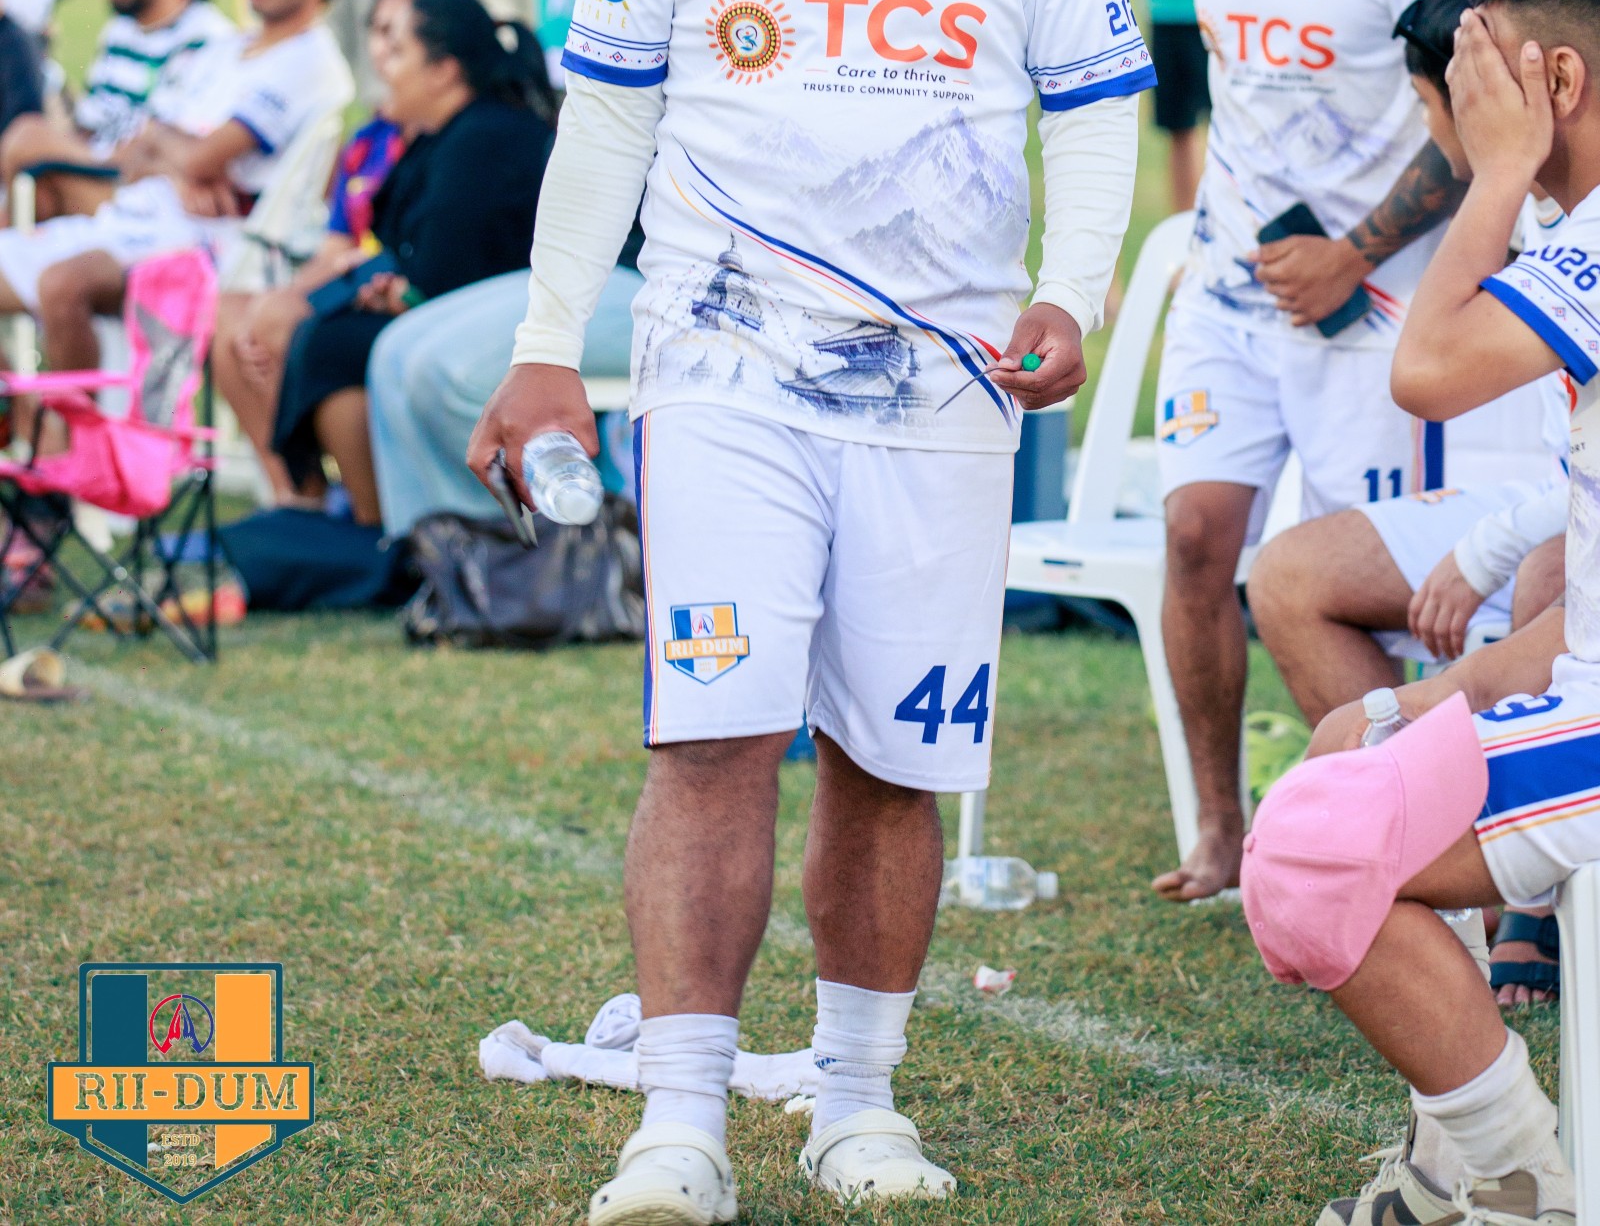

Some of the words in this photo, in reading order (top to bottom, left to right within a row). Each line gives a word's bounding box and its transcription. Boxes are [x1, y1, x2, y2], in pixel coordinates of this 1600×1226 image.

[1226, 13, 1336, 71] TCS
[837, 65, 877, 78] Care
[883, 67, 898, 79] to
[903, 68, 947, 84] thrive
[803, 83, 855, 93] TRUSTED
[859, 85, 929, 98] COMMUNITY
[932, 90, 975, 102] SUPPORT
[1363, 468, 1403, 503] 11
[670, 637, 745, 658] RII-DUM
[894, 663, 990, 744] 44
